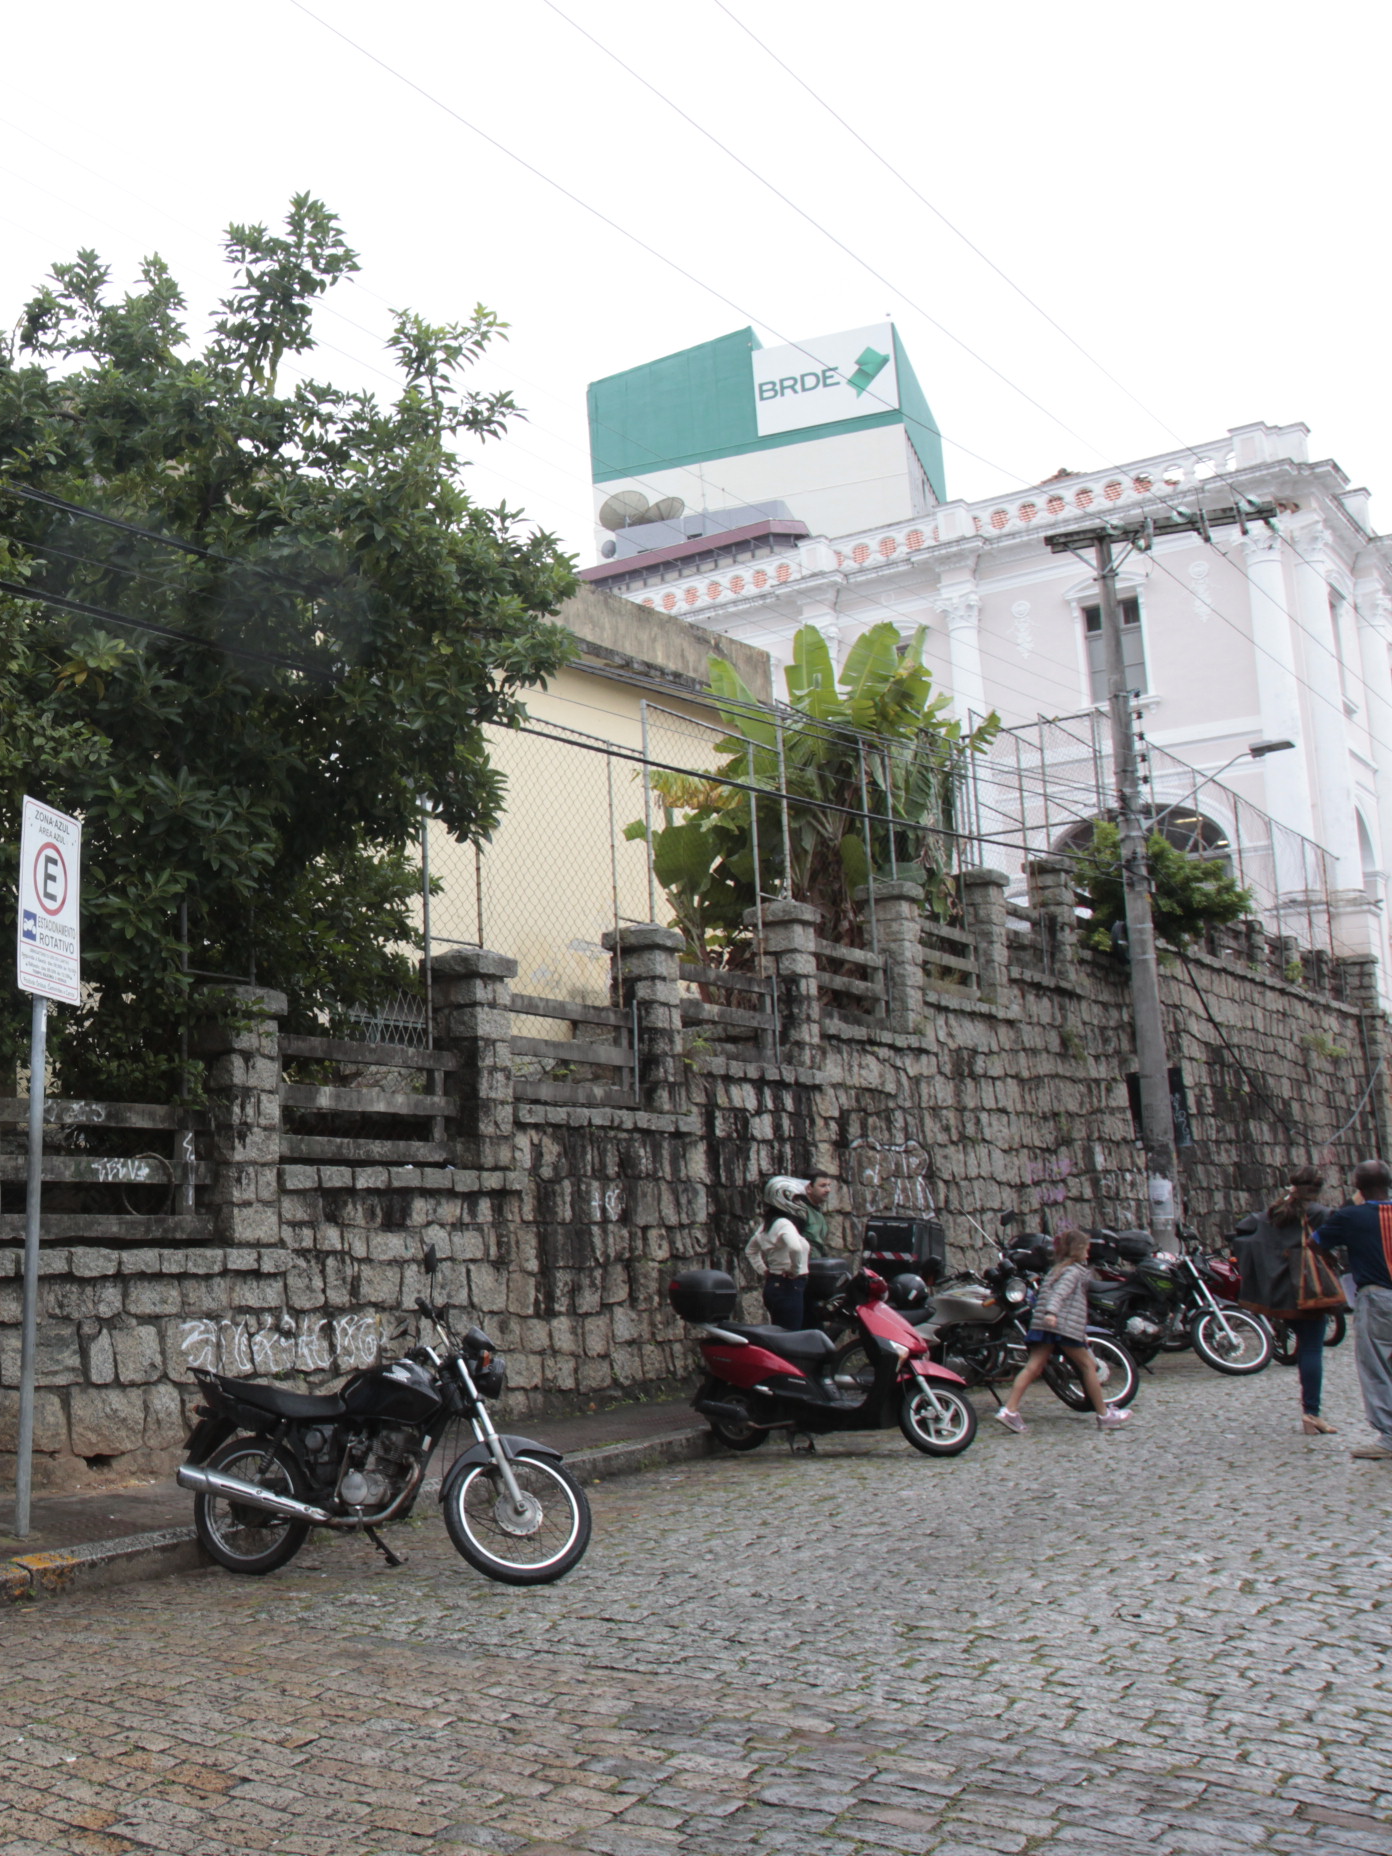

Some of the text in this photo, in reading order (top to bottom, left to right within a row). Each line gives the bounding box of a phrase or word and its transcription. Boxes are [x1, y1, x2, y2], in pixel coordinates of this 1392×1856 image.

[758, 367, 841, 402] BRDE
[34, 809, 70, 835] ZONA AZUL
[53, 833, 66, 845] AZUL
[43, 854, 59, 903] E
[37, 915, 76, 940] ESTACIONAMENTO
[39, 932, 75, 955] ROTATIVO
